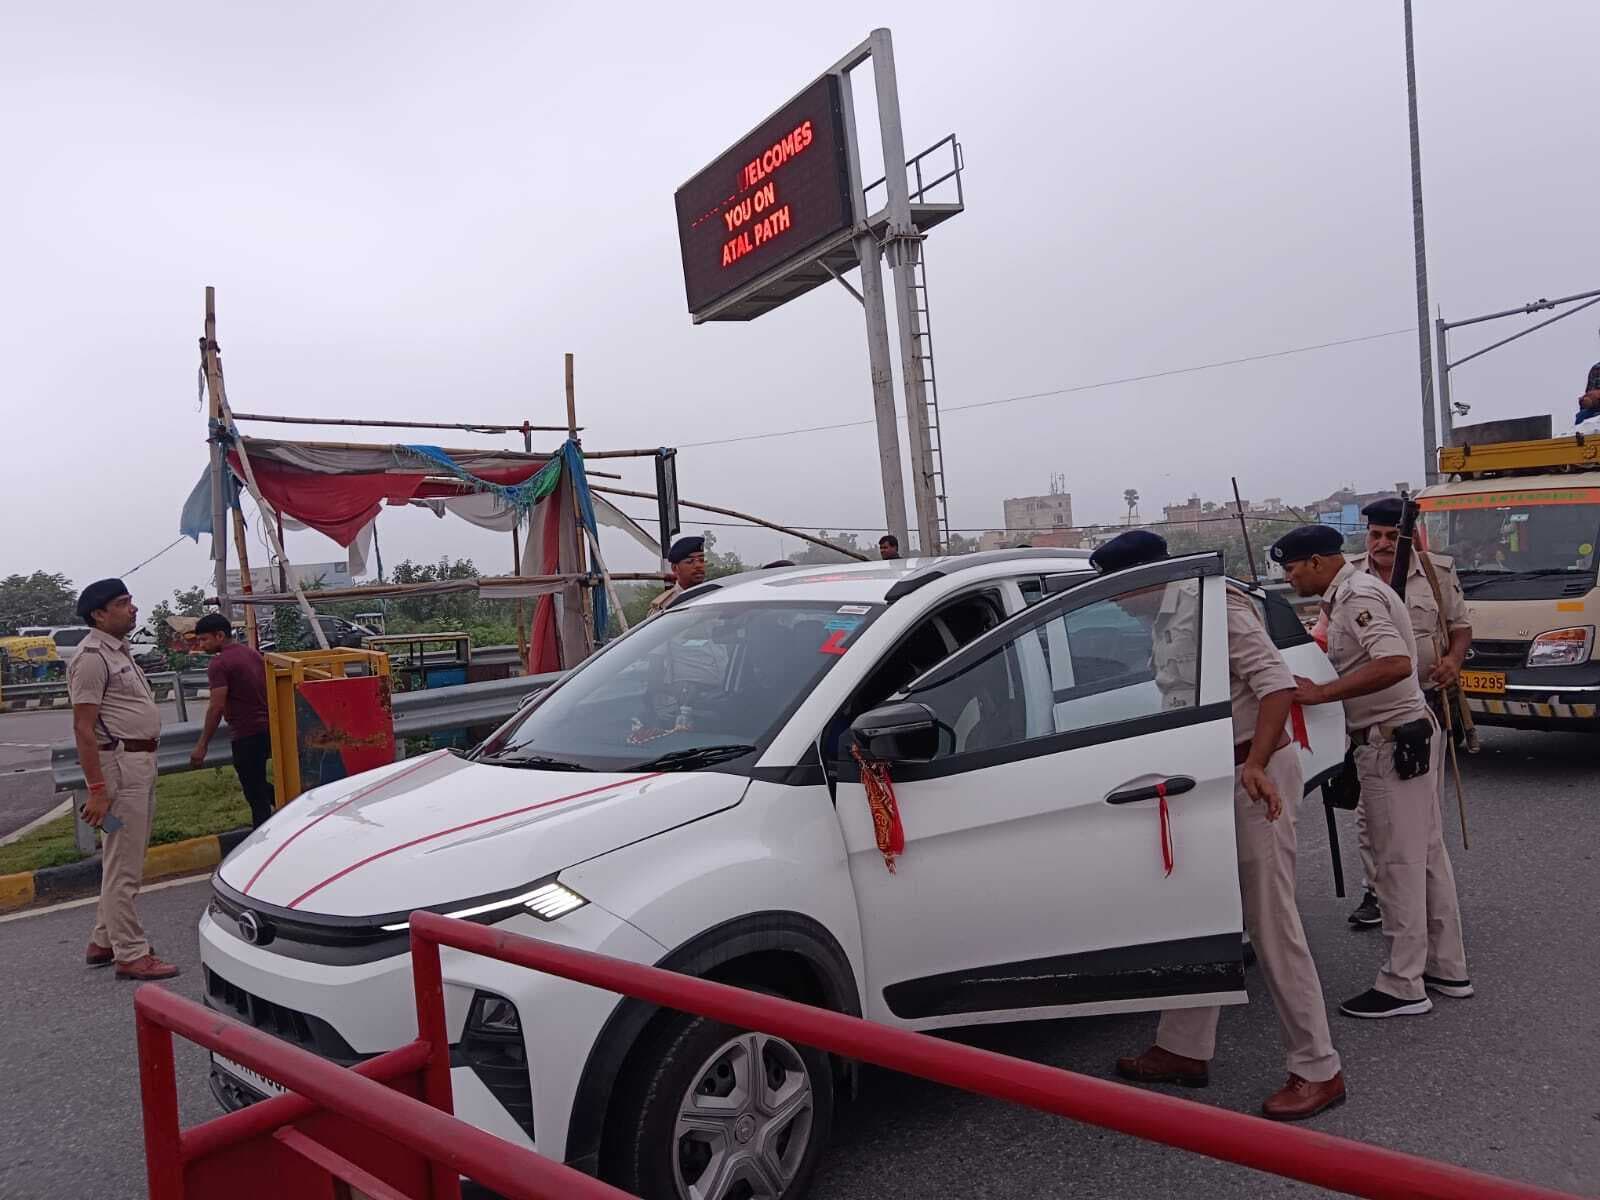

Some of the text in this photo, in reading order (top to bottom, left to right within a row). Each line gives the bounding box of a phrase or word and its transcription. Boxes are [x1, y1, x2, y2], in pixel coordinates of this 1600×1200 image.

[724, 197, 752, 231] YOU
[754, 182, 775, 212] ON
[722, 235, 753, 267] ATAL
[754, 205, 791, 247] PATH
